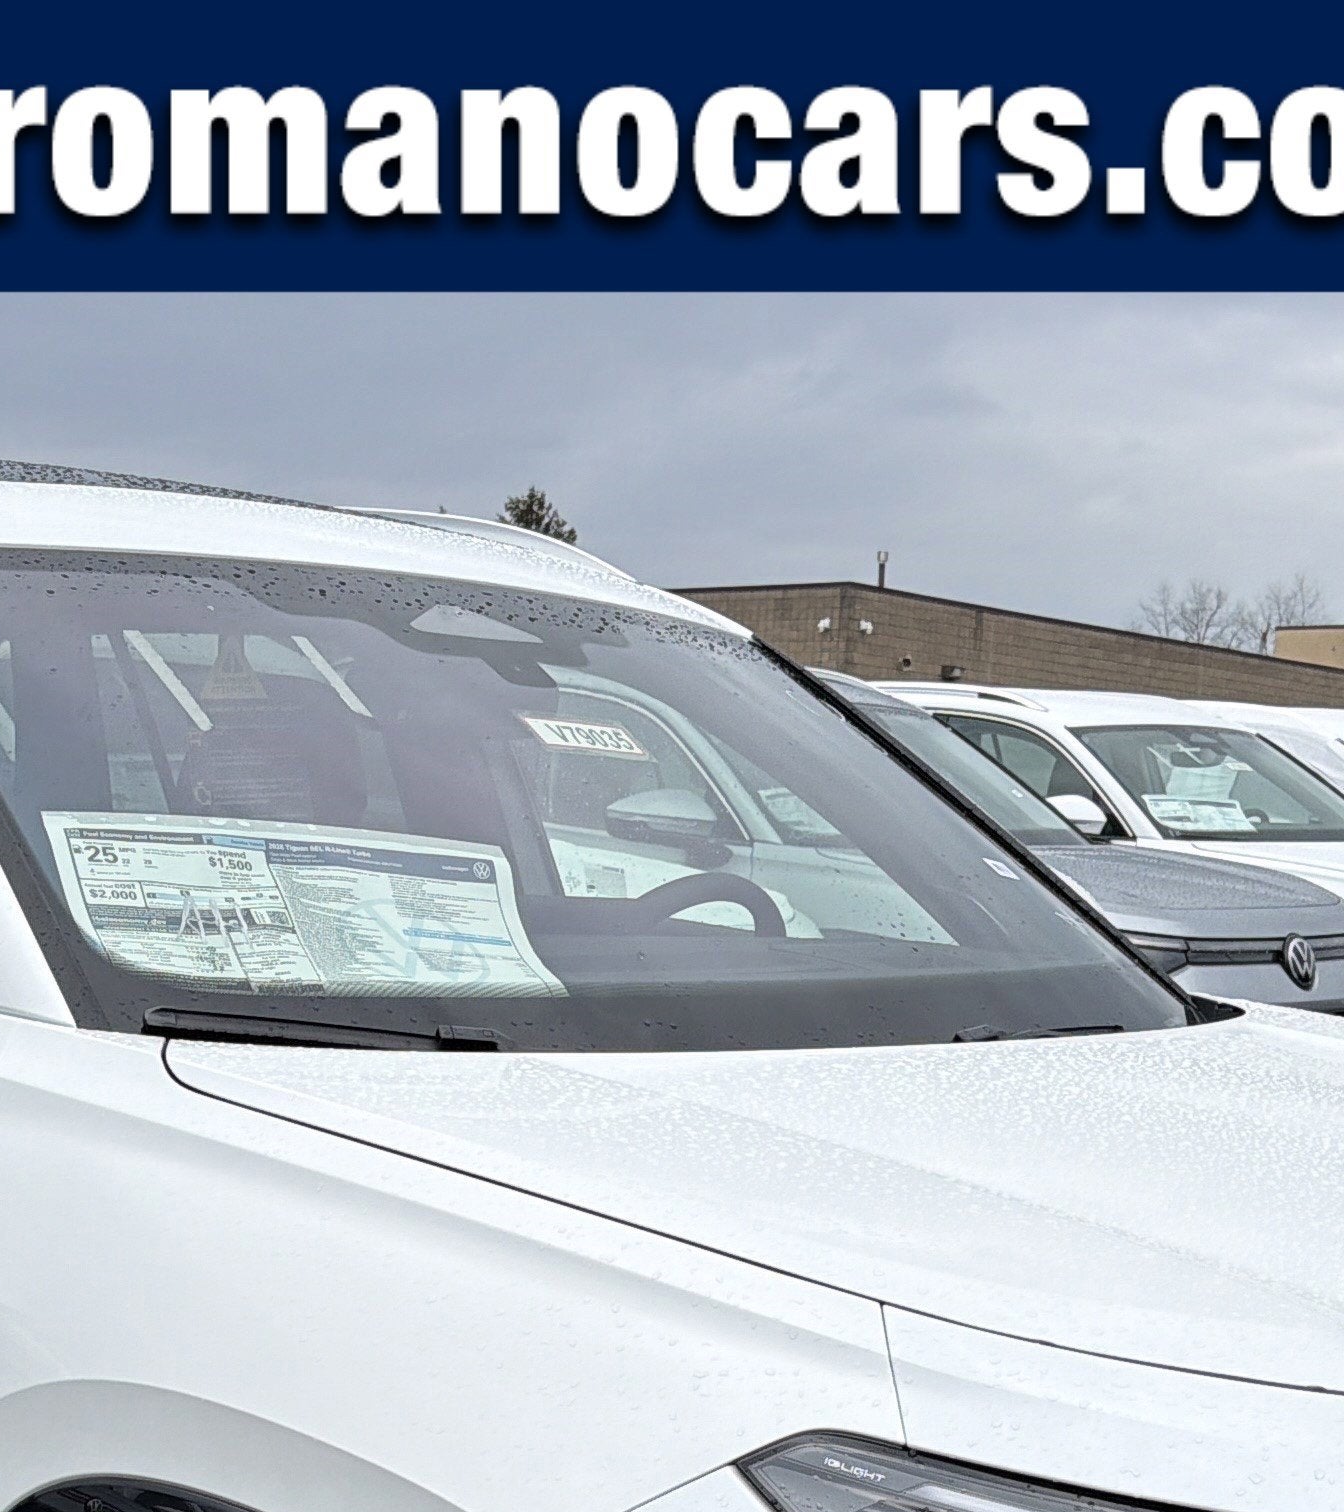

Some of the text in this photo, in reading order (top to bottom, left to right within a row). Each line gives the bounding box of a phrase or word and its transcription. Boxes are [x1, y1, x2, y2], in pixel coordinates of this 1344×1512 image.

[544, 723, 635, 750] V79035
[84, 845, 118, 864] 25
[218, 850, 246, 860] spend
[208, 856, 253, 871] $1,500
[89, 888, 137, 900] $2,000
